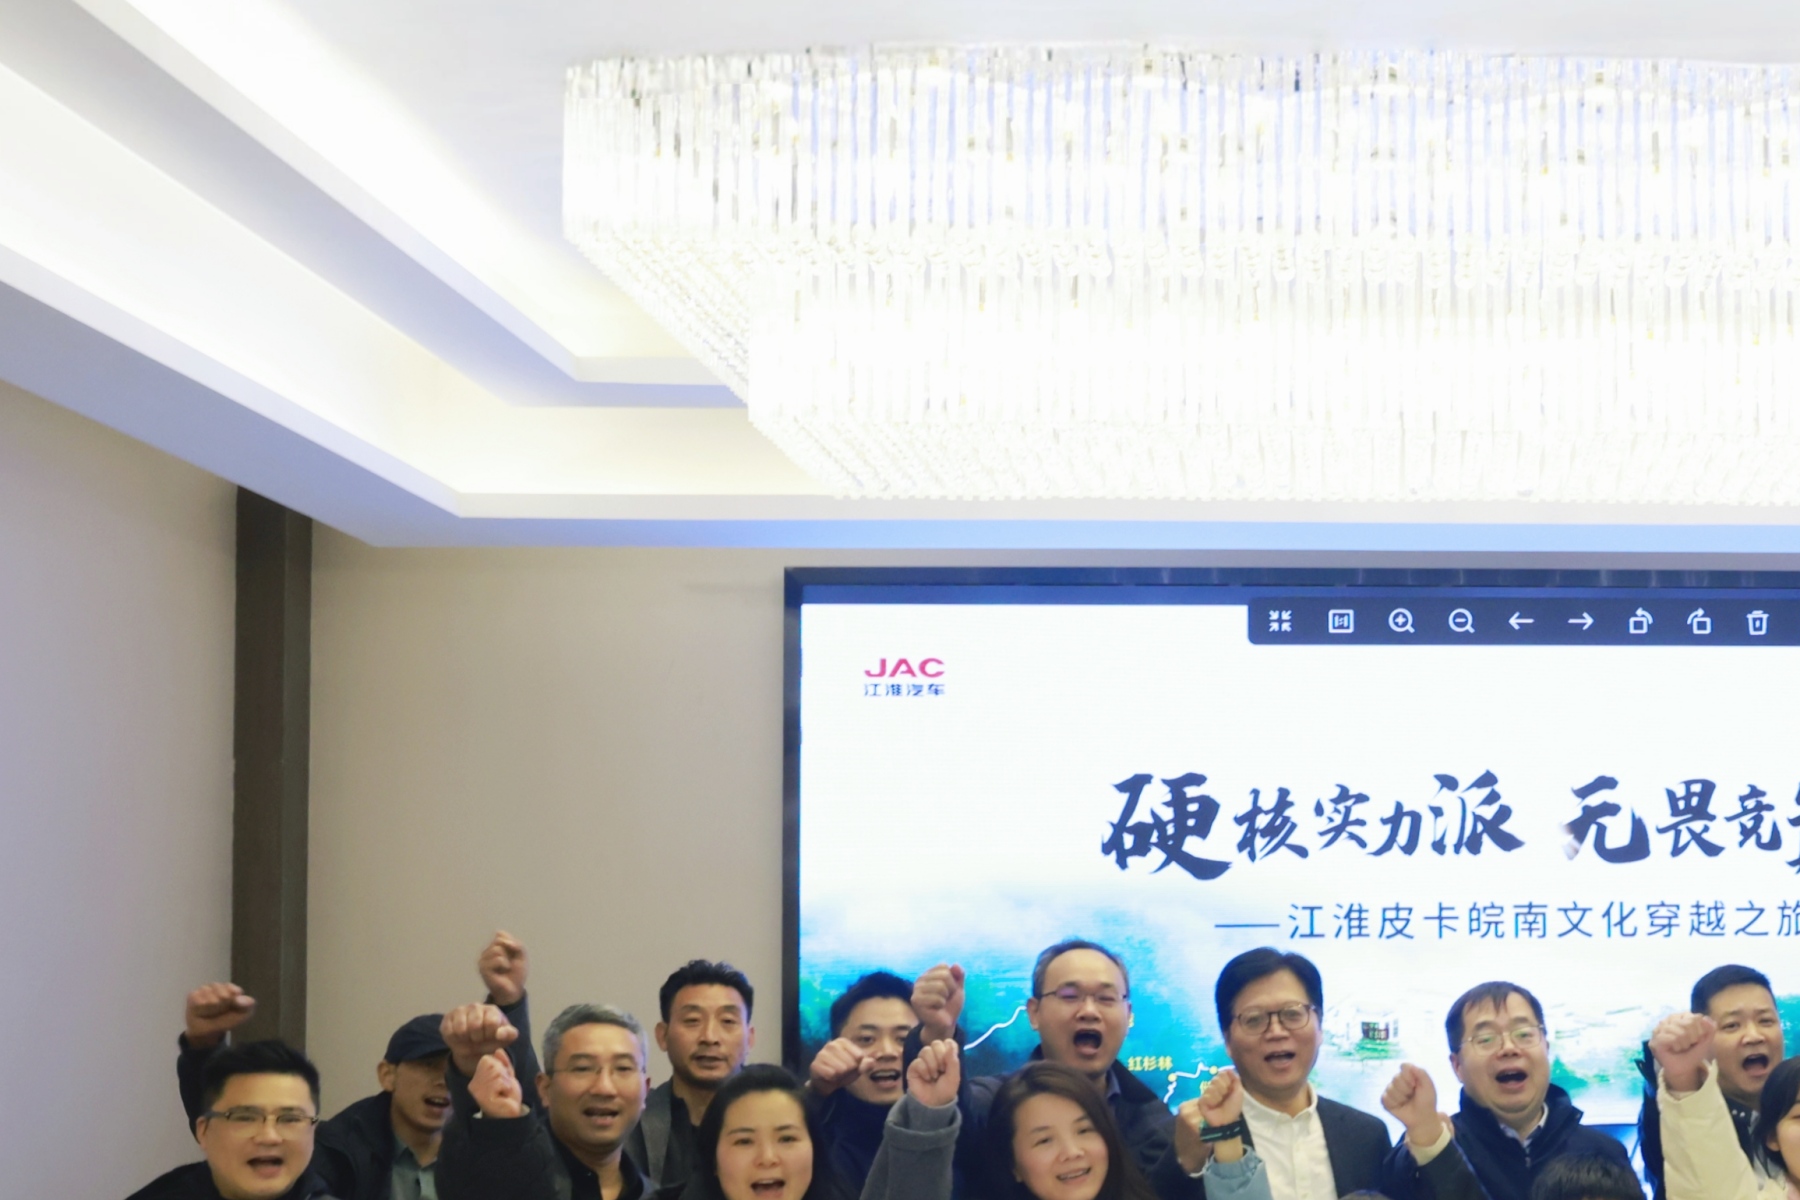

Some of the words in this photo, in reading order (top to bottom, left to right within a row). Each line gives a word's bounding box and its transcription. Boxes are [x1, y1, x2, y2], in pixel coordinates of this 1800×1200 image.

[864, 657, 945, 678] JAC
[863, 683, 945, 697] 江淮汽车
[1102, 770, 1526, 881] 硬核实力派
[1127, 1055, 1173, 1071] 红杉林
